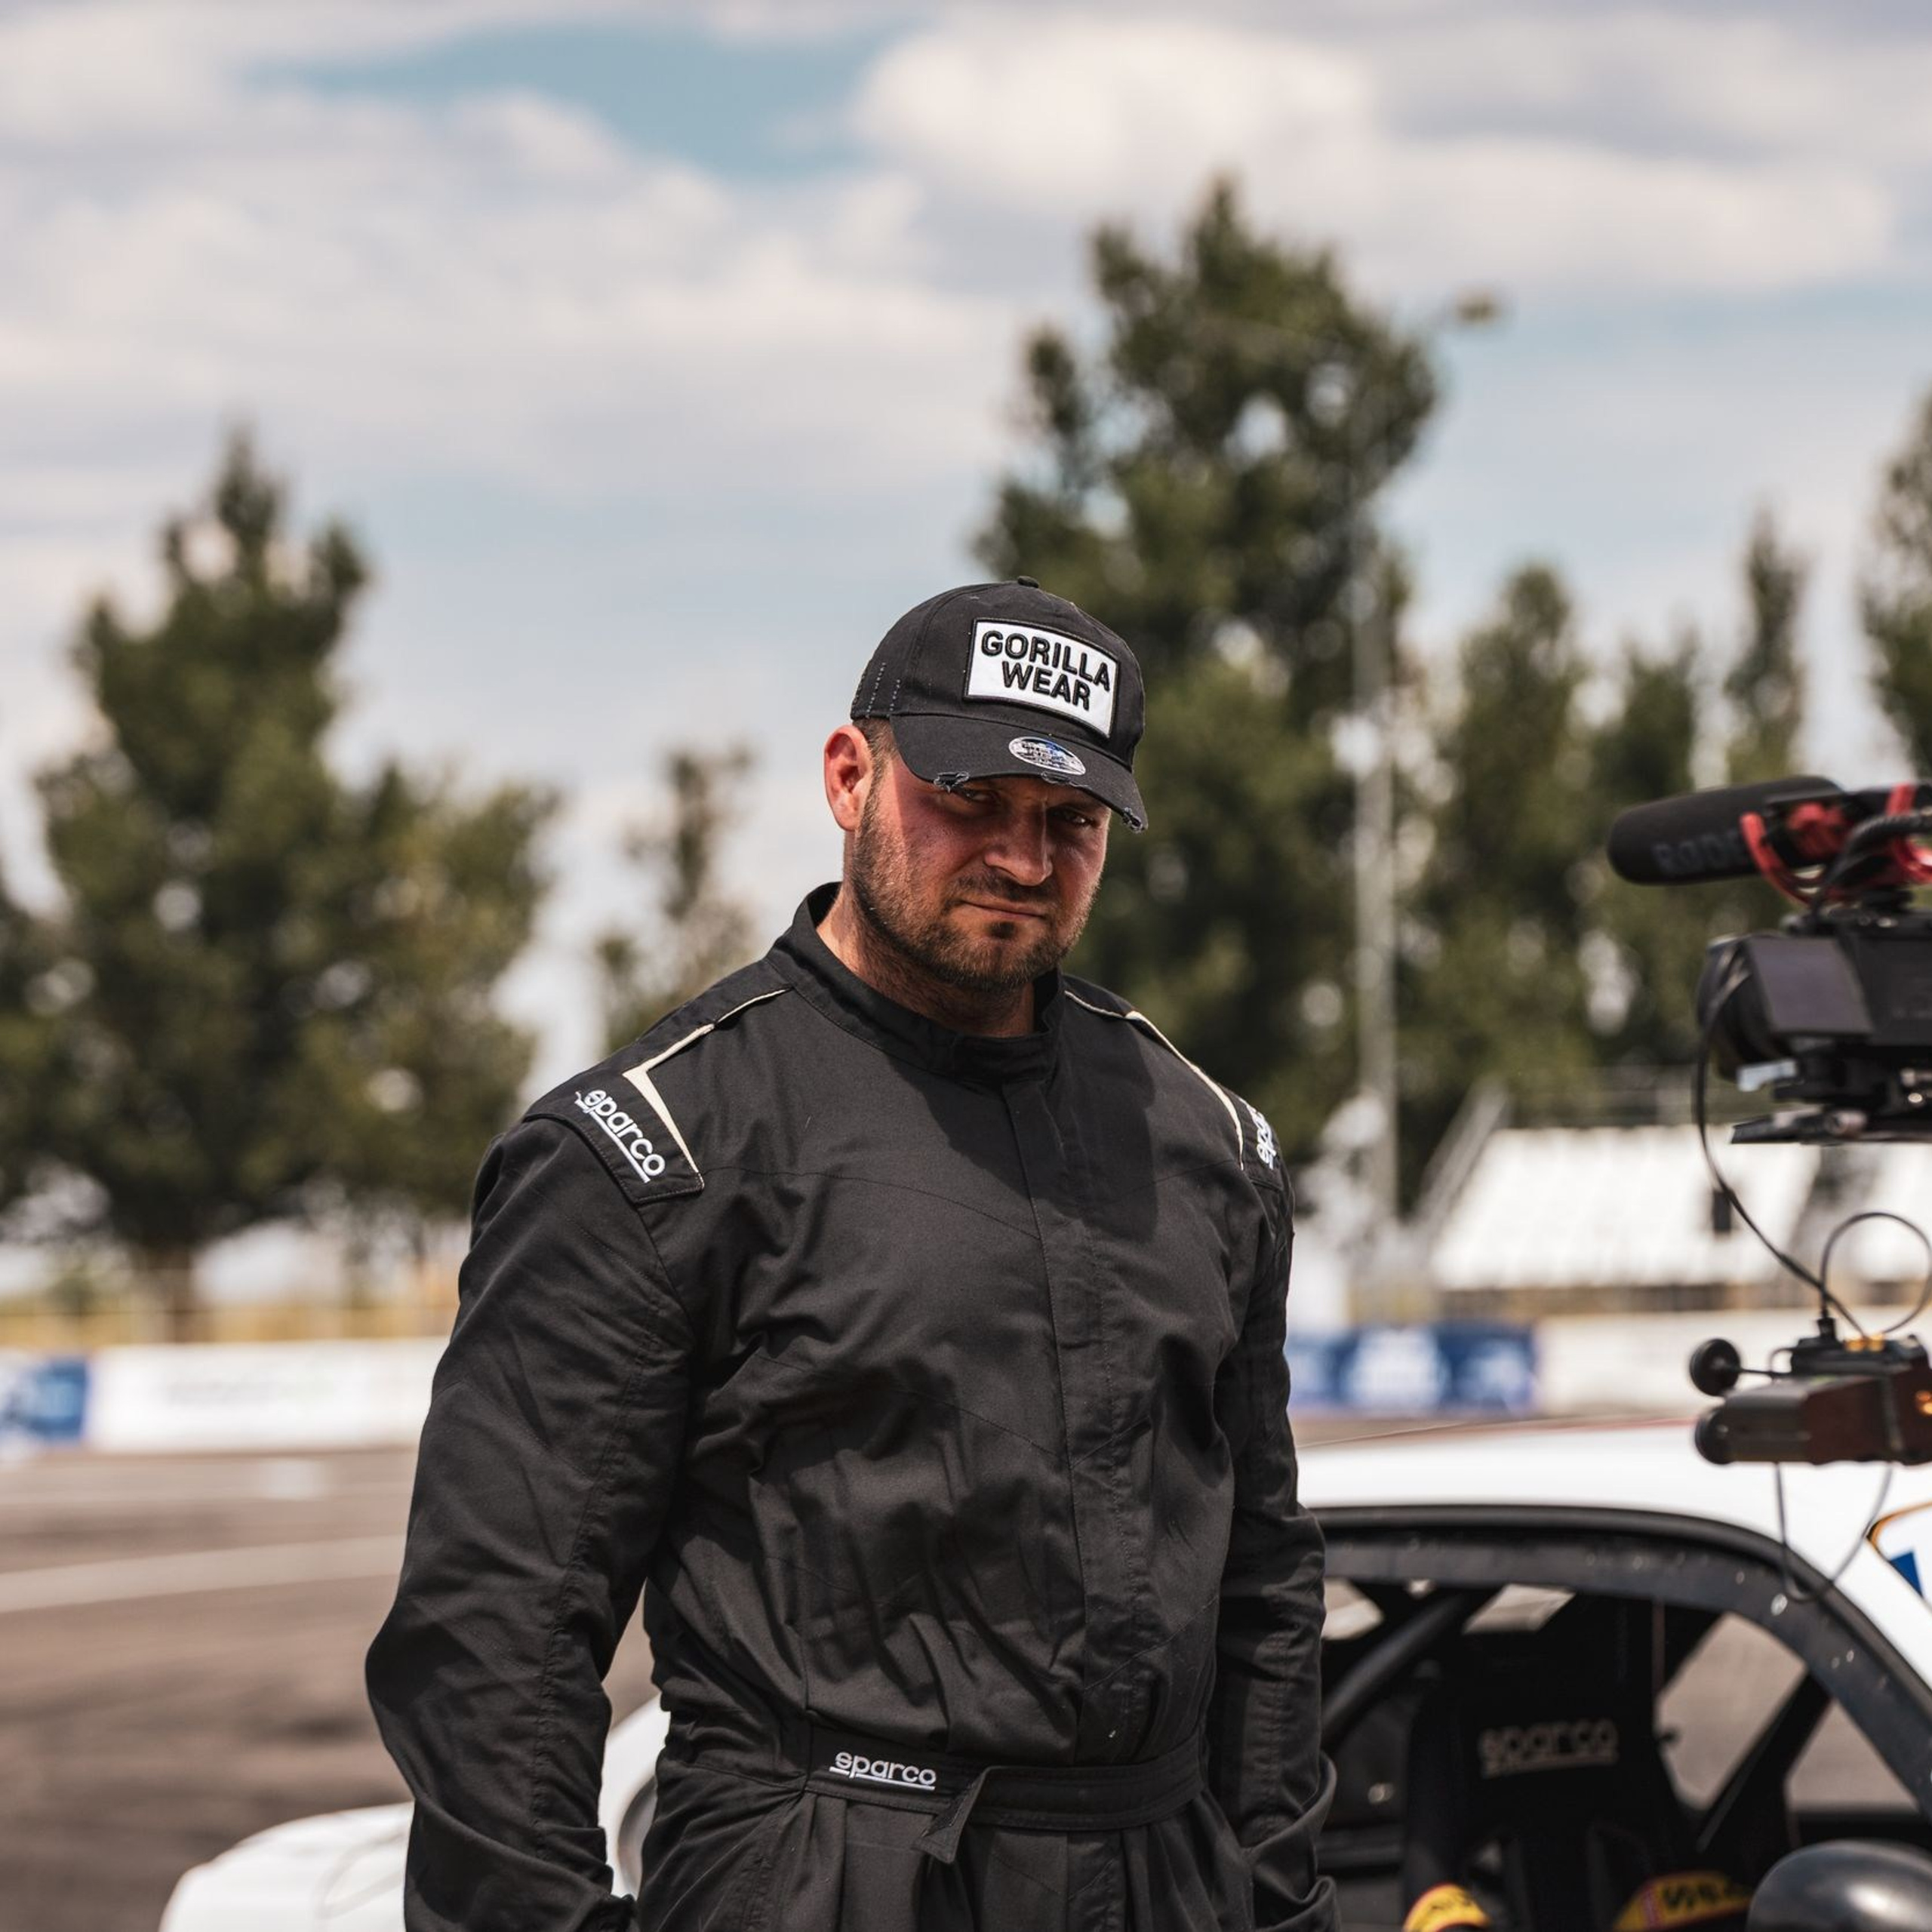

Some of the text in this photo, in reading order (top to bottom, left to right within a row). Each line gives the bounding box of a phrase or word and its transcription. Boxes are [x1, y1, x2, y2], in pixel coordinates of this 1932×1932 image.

[981, 630, 1111, 692] GORILLA
[1001, 660, 1091, 711] WEAR
[574, 1090, 666, 1183] sparco
[829, 1752, 937, 1790] sparco
